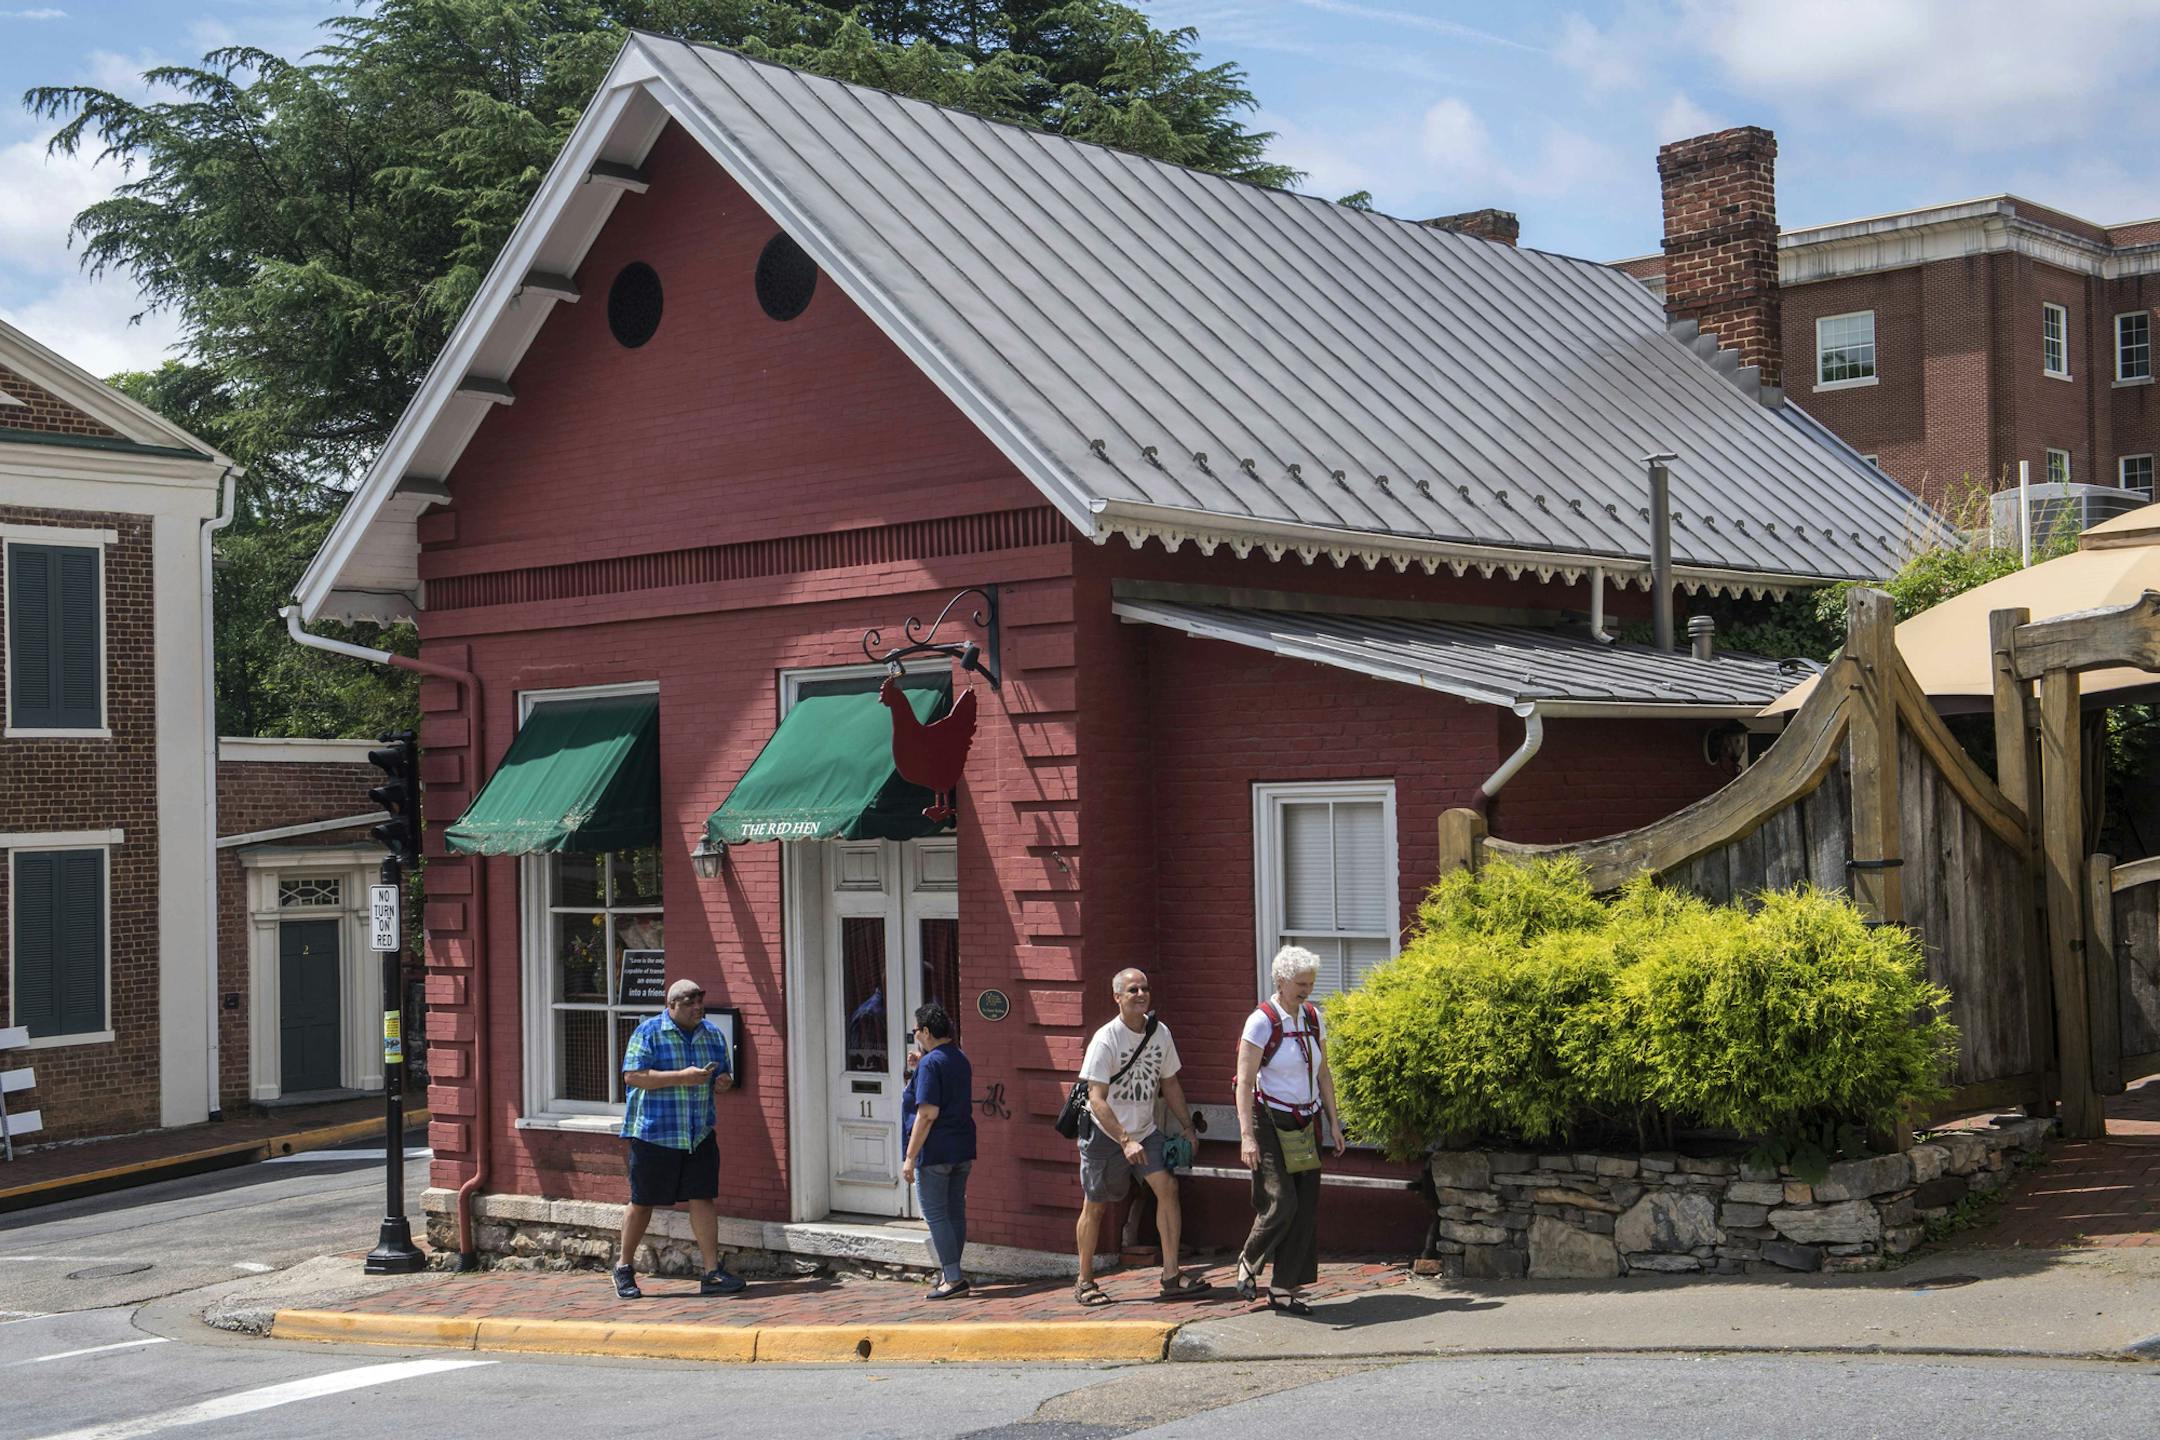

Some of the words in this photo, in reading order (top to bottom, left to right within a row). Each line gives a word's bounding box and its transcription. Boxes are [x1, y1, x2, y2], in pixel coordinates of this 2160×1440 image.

[741, 823, 767, 836] THE
[766, 821, 792, 835] RED
[792, 821, 821, 834] HEN
[378, 889, 390, 902] NO
[374, 904, 395, 917] TURN
[379, 919, 390, 932] ON
[377, 934, 393, 947] RED
[303, 944, 309, 955] 2
[645, 978, 665, 986] enemy
[629, 988, 642, 997] into
[642, 989, 647, 997] a
[860, 1099, 873, 1118] 11
